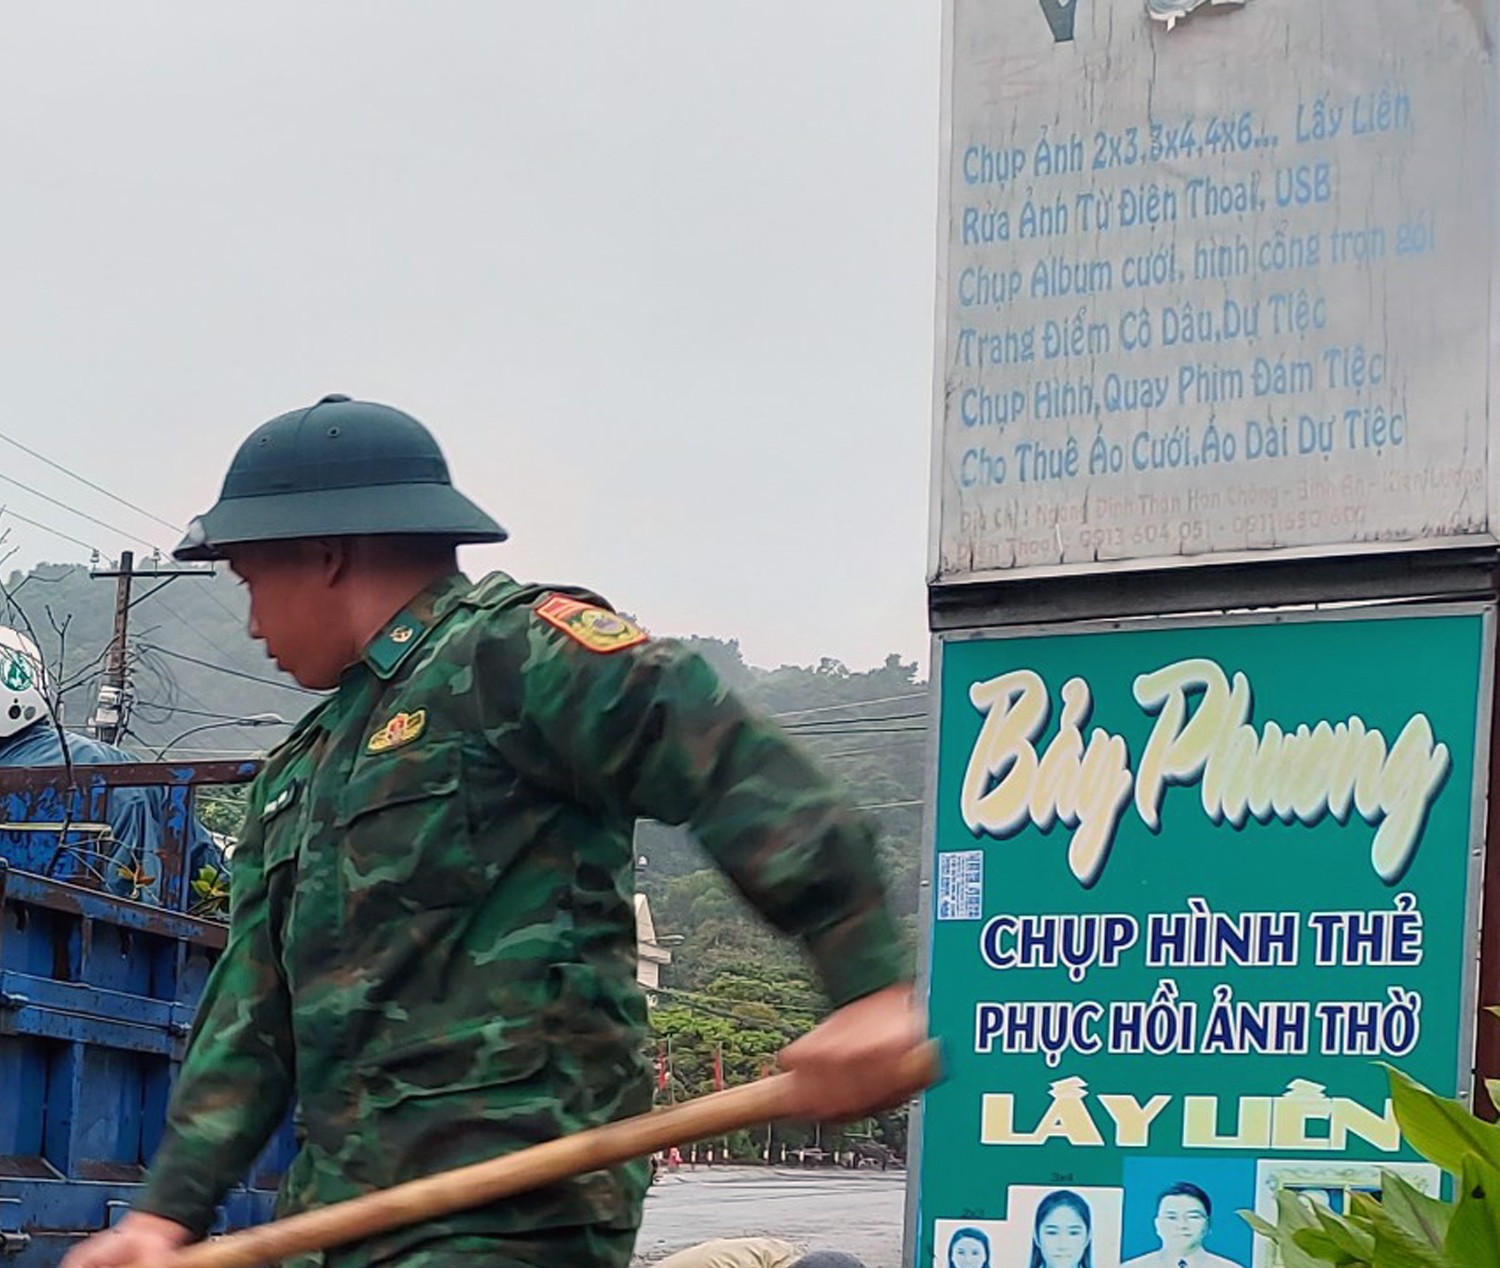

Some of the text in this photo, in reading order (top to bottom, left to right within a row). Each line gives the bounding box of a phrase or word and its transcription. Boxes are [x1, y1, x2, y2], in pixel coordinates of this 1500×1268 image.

[963, 145, 1027, 192] Chụp
[1034, 124, 1085, 178] Ảnh
[1295, 89, 1344, 144] Lấy
[963, 200, 1011, 246] Rửa
[1018, 186, 1068, 239] Ảnh
[1117, 183, 1177, 233] Điện
[1275, 161, 1332, 207] USB
[958, 265, 1023, 312] Chụp
[1031, 256, 1113, 299] Album
[1193, 234, 1249, 280] hình
[957, 325, 1036, 368] Trang
[1041, 305, 1111, 360] Điểm
[1119, 305, 1152, 352] Cô
[1267, 288, 1327, 341] Tiệc
[961, 386, 1026, 434] Chụp
[1178, 363, 1243, 405] Phim
[1250, 352, 1313, 397] Đám
[1322, 346, 1385, 397] Tiệc
[961, 446, 1007, 488] Cho
[1014, 436, 1079, 483] Thuê
[1088, 424, 1124, 476] Áo
[1245, 416, 1289, 460] Dài
[1298, 413, 1337, 463] Dự
[1343, 404, 1404, 457] Tiệc
[979, 892, 1424, 983] CHỤP HÌNH THẺ
[973, 977, 1422, 1068] PHỤC HỒI ẢNH THỜ
